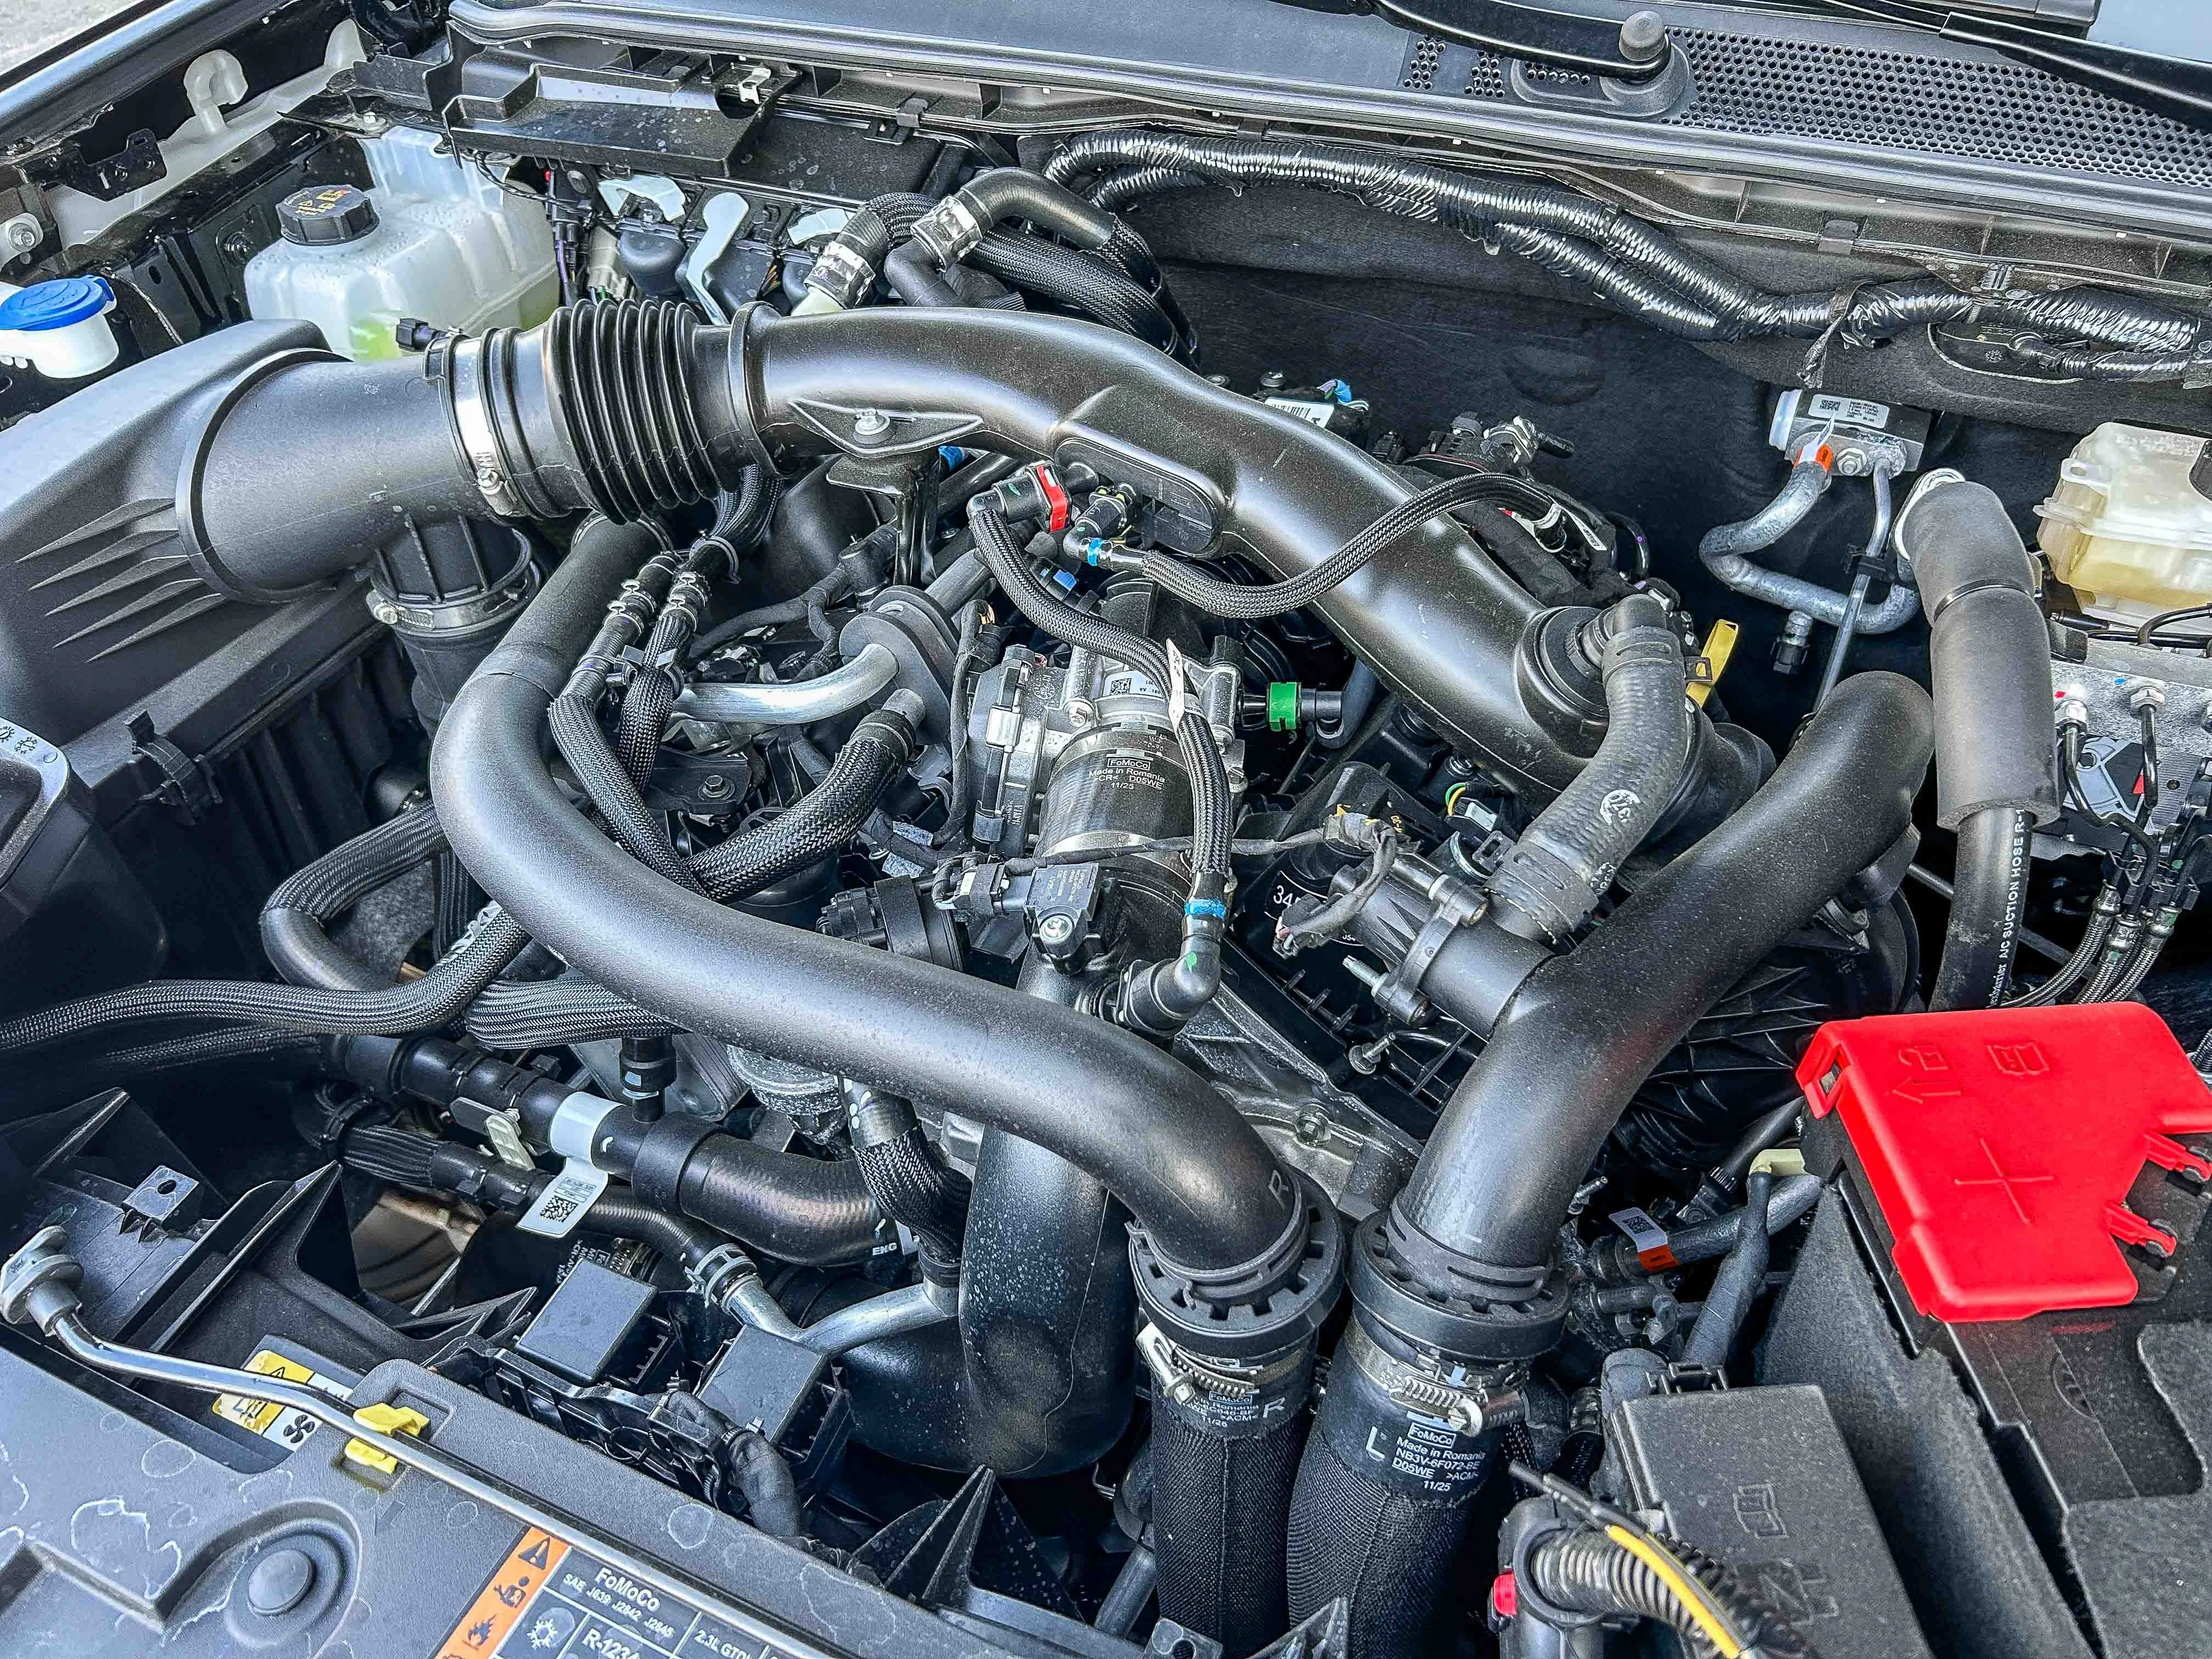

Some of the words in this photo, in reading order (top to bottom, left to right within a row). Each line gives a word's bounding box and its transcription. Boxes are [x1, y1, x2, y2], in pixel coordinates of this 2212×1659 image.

[1110, 759, 1148, 769] FoMoCo
[1088, 768, 1114, 777] Made
[1126, 768, 1166, 783] Romania
[1128, 775, 1164, 790] D05WE
[2002, 881, 2019, 939] SUCTION
[2011, 837, 2024, 878] HOSE
[1268, 1169, 1289, 1211] R
[872, 1242, 898, 1256] ENG
[1262, 1397, 1286, 1418] R
[1365, 1425, 1386, 1459] L
[1410, 1427, 1453, 1444] FoMoCo
[1396, 1436, 1429, 1454] Made
[1430, 1447, 1441, 1457] in
[1442, 1450, 1486, 1460] Romania
[1392, 1457, 1435, 1479] D05WE
[1423, 1480, 1452, 1492] 11/25
[562, 1573, 586, 1593] SAE
[586, 1586, 612, 1606] J639
[612, 1600, 643, 1622] J2842
[594, 1567, 661, 1612] FoMoCo
[693, 1629, 720, 1654] 2.3L
